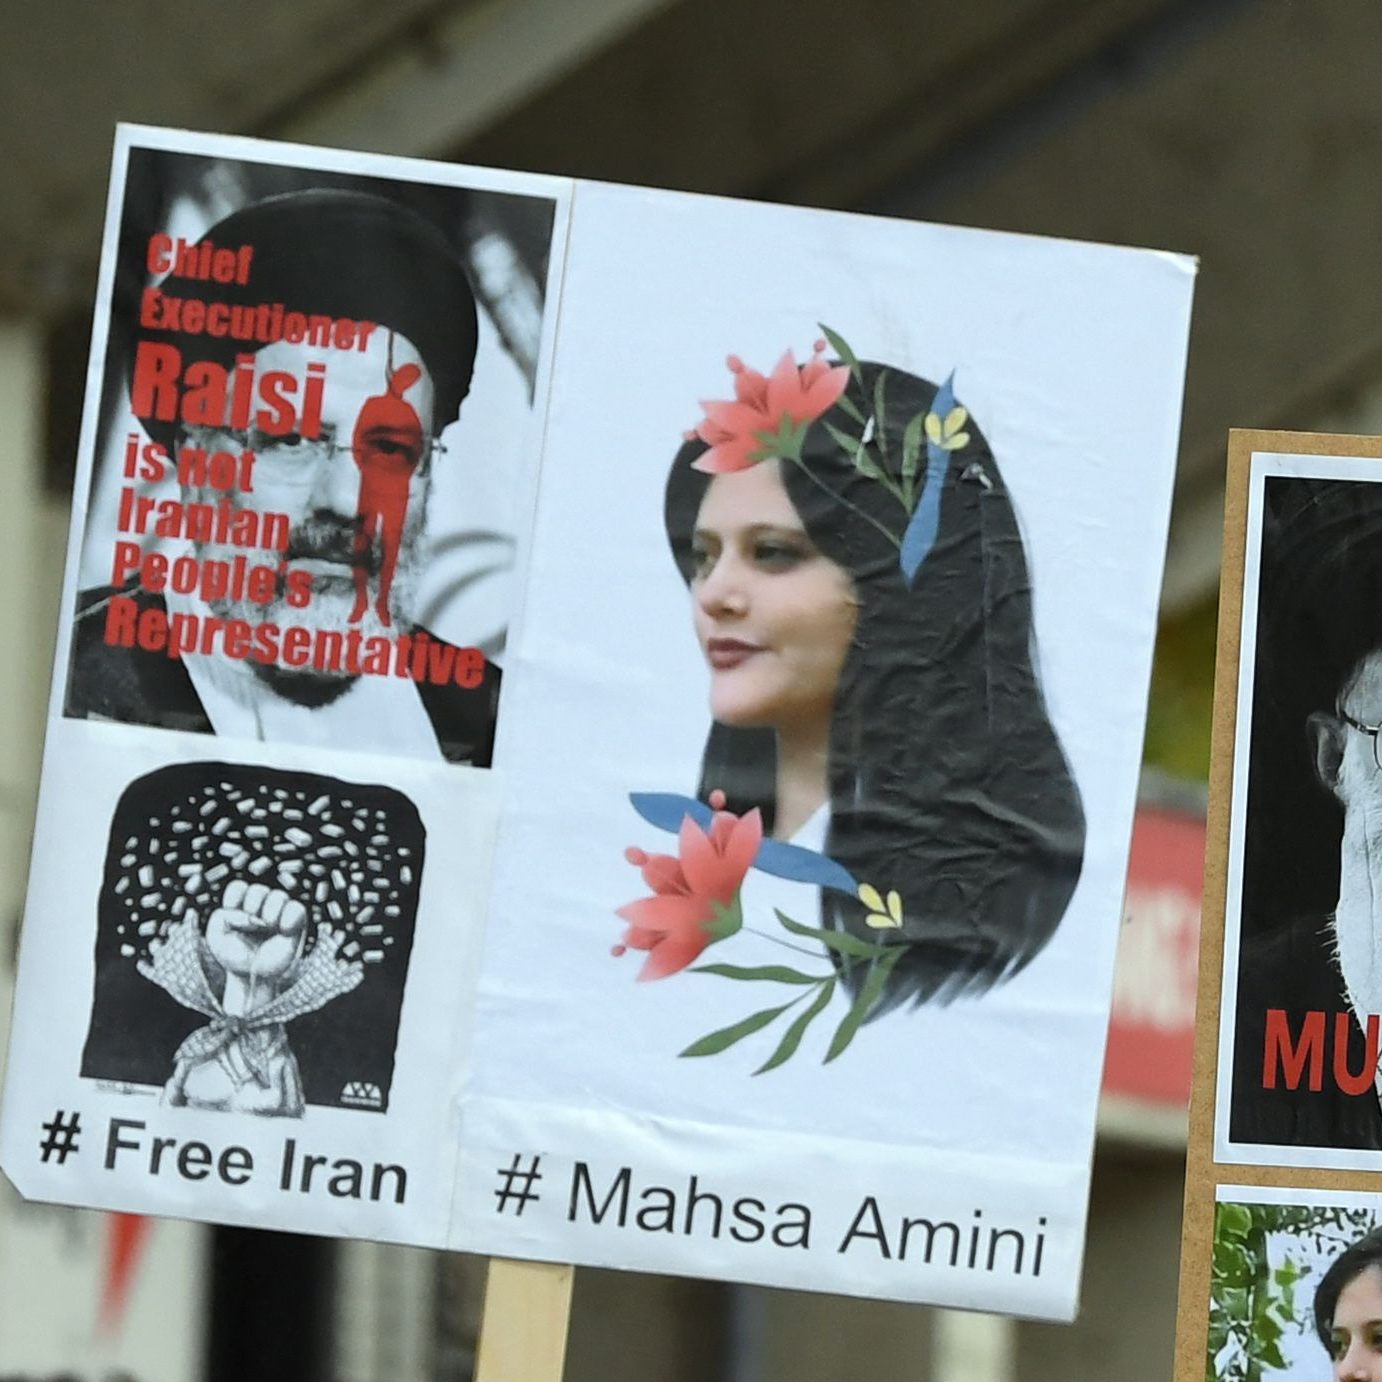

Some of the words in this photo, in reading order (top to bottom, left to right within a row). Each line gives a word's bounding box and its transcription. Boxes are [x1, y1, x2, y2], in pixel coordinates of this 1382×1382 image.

[147, 231, 254, 285] Chief
[140, 287, 377, 352] Executioner
[131, 340, 327, 439] Raisi
[123, 433, 168, 483] is
[177, 447, 256, 493] not
[116, 487, 290, 552] Iranian
[111, 541, 313, 608] People's
[104, 595, 486, 689] Representative
[40, 1110, 82, 1165] #
[104, 1117, 254, 1186] Free
[279, 1139, 408, 1204] Iran
[494, 1153, 543, 1218] #
[567, 1161, 813, 1249] Mahsa
[838, 1196, 1048, 1277] Amini
